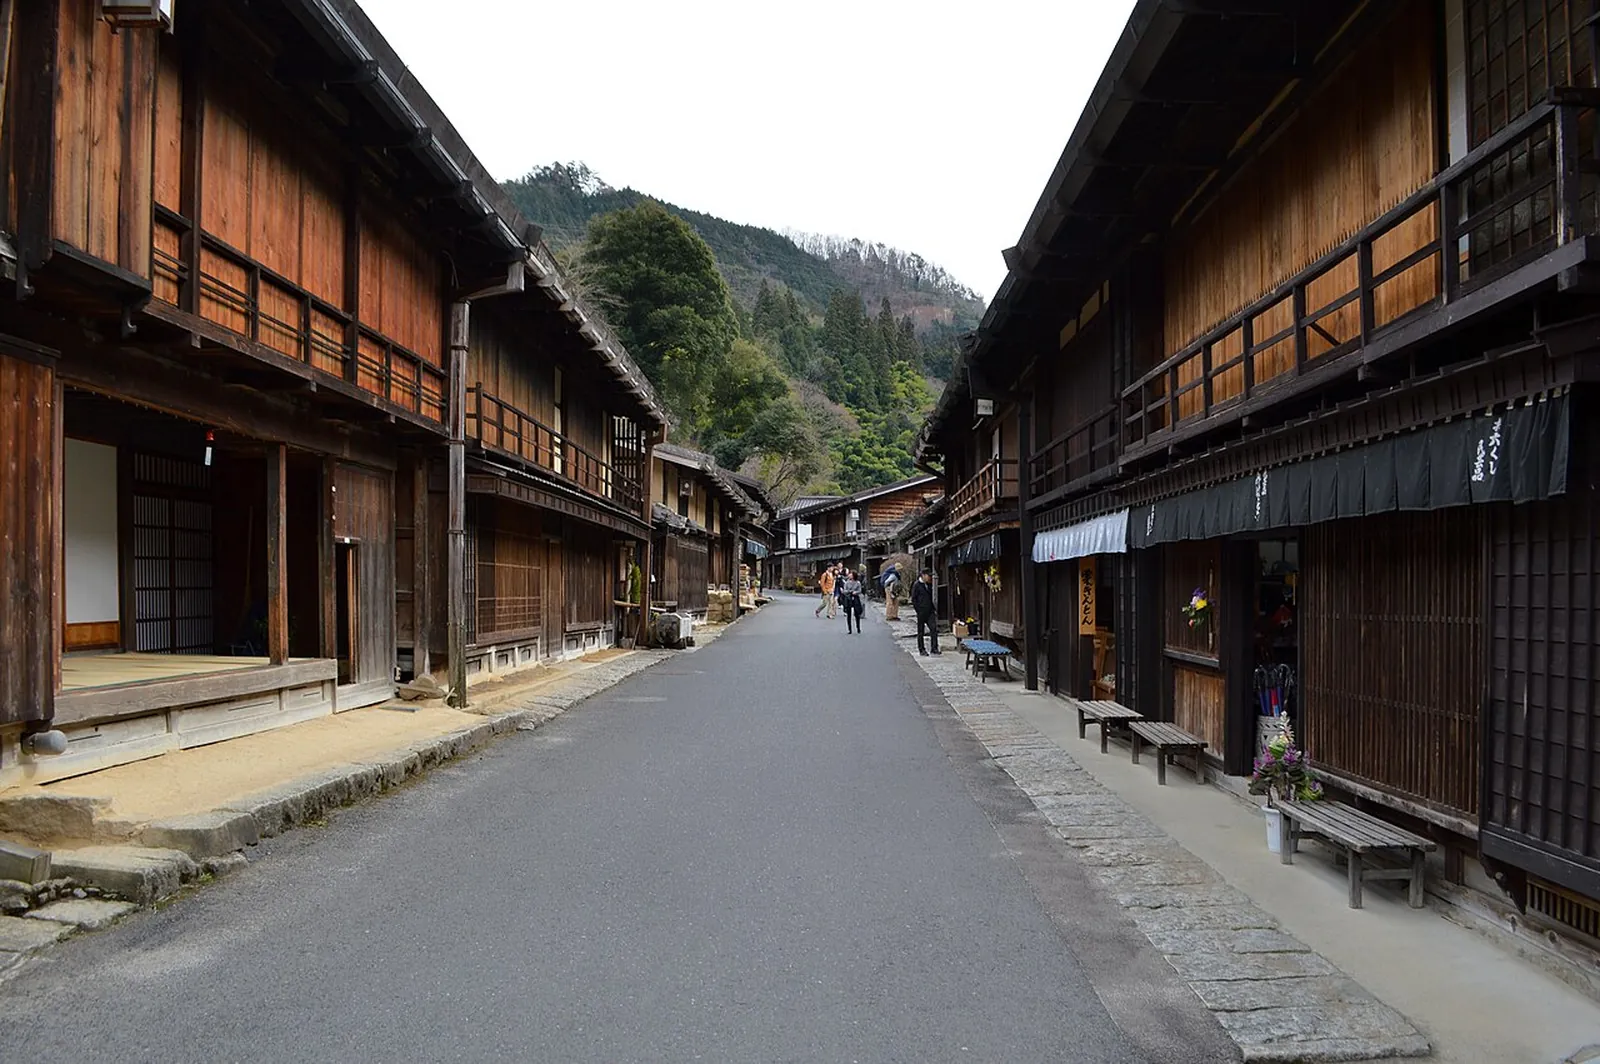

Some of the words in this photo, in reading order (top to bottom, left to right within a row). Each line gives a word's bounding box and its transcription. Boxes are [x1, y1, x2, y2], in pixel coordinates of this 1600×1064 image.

[1081, 568, 1094, 625] 栗きんとん
